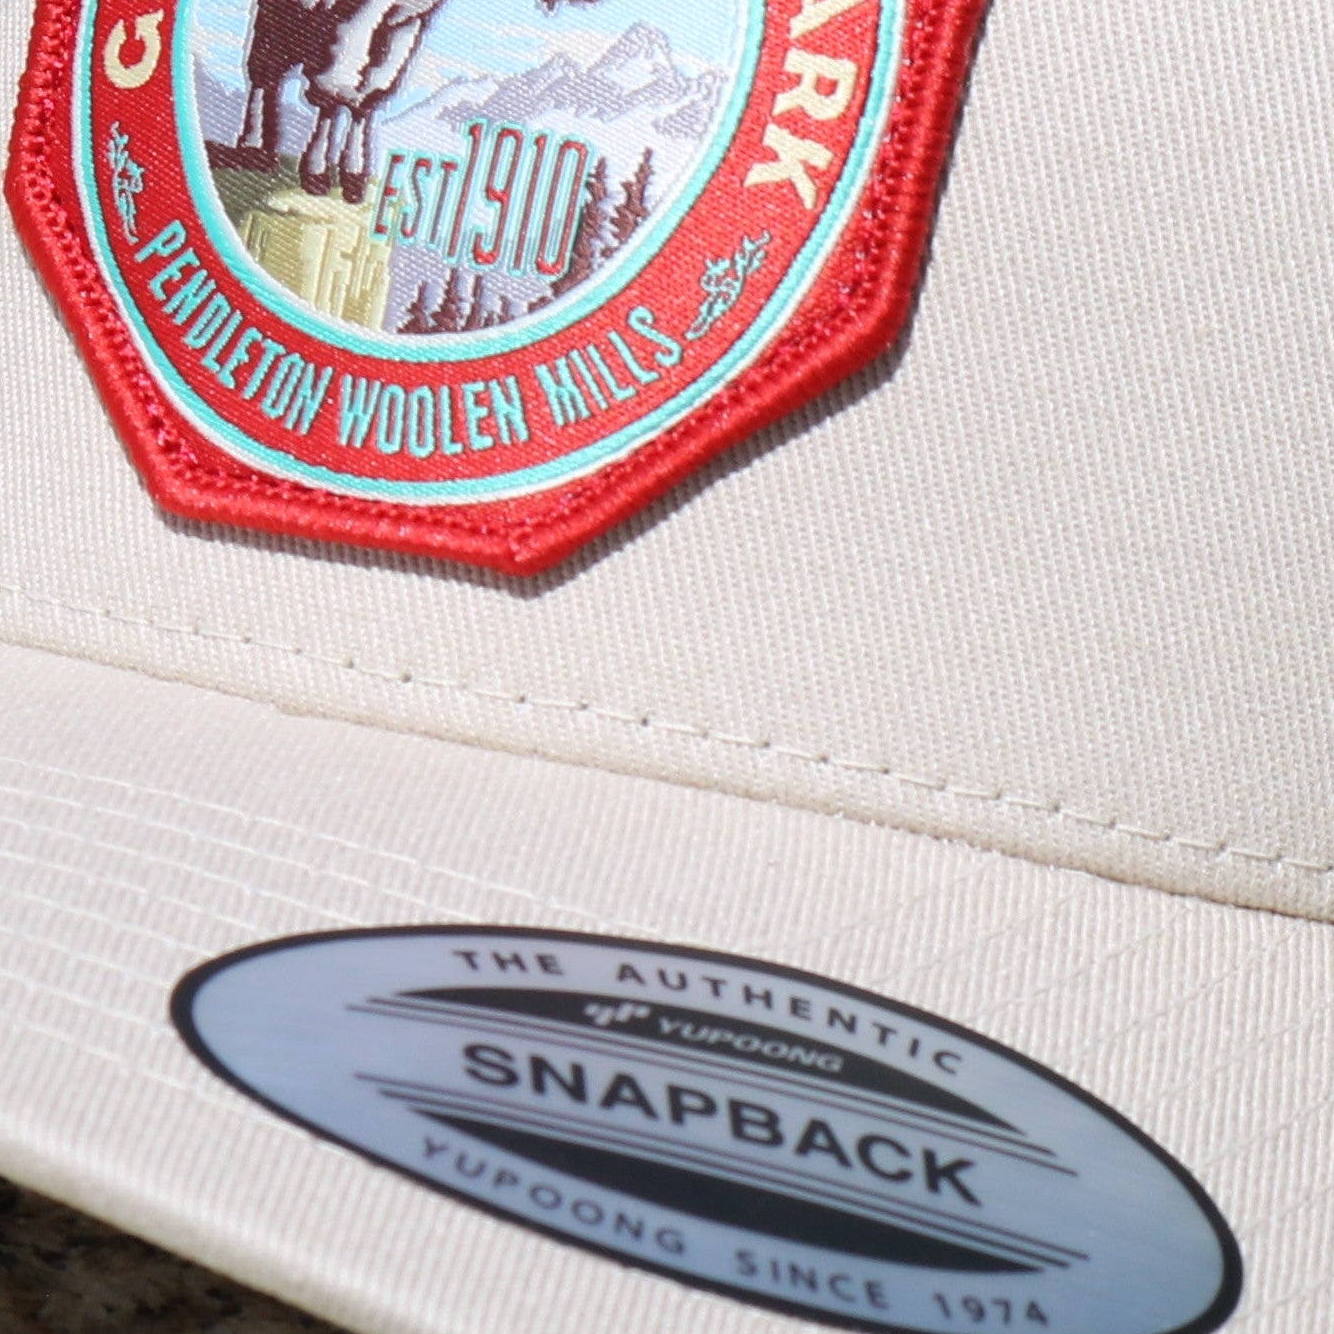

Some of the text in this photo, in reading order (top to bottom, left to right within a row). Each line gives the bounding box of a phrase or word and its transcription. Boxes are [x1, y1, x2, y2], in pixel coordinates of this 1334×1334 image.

[443, 118, 593, 281] 1910
[137, 219, 683, 457] PENDLETON WOOLEN MILLS
[454, 949, 965, 1075] THE AUTHENTIC
[657, 1016, 844, 1074] YUPOONG
[461, 1043, 983, 1207] SNAPBACK
[419, 1136, 1051, 1329] YUPOONG SINCE 1974
